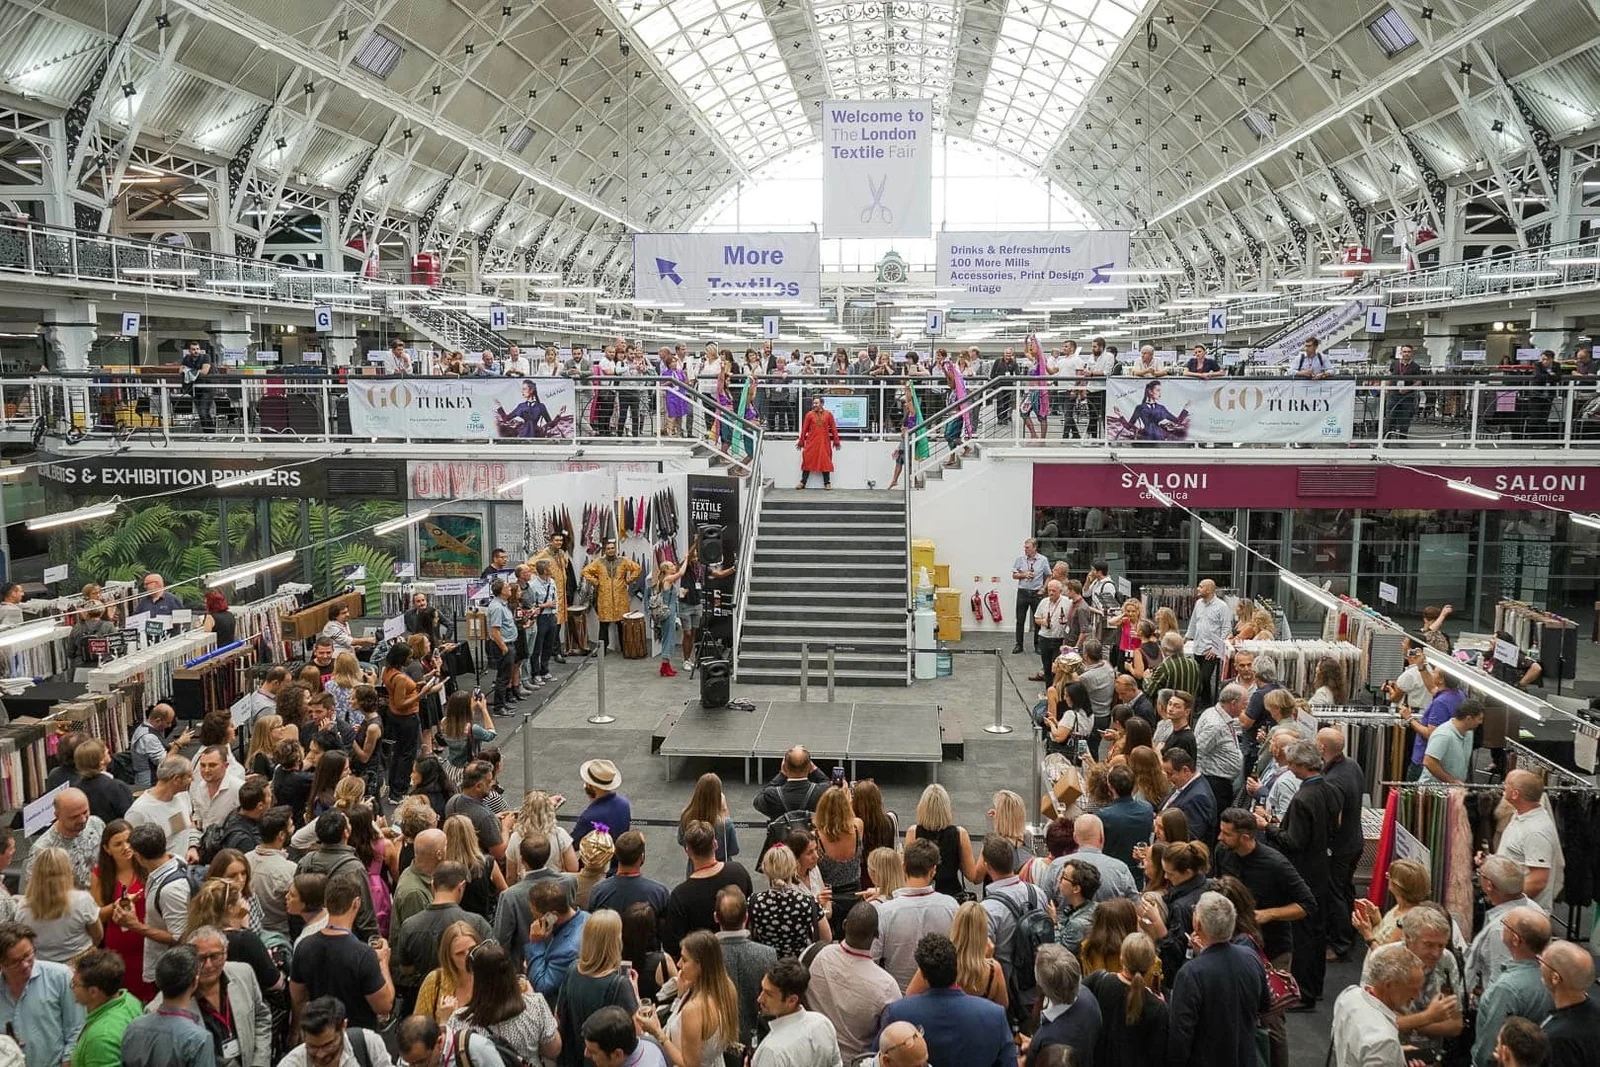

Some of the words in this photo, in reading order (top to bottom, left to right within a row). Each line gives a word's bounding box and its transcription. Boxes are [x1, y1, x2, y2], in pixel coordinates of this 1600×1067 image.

[831, 110, 903, 123] Welcome
[908, 109, 924, 122] to
[831, 128, 858, 141] The
[861, 127, 916, 141] London
[831, 145, 884, 159] Textile
[889, 145, 916, 158] Fair
[724, 245, 783, 265] More
[951, 245, 984, 255] Drinks
[987, 245, 996, 255] &
[1000, 245, 1071, 254] Refreshments
[951, 258, 971, 267] 100
[975, 258, 1001, 267] More
[1005, 258, 1030, 267] Mills
[950, 271, 1017, 281] Accessories,
[1020, 270, 1045, 280] Print
[1049, 270, 1084, 282] Design
[962, 283, 1002, 294] intage
[126, 318, 137, 331] F
[317, 312, 330, 326] G
[493, 311, 504, 325] H
[930, 315, 938, 329] J
[1211, 314, 1224, 329] K
[1371, 312, 1381, 327] L
[415, 384, 474, 396] WITH
[1268, 386, 1333, 398] WITH
[415, 396, 474, 409] TURKEY
[1267, 399, 1331, 412] TURKEY
[82, 467, 97, 484] &
[101, 468, 206, 486] EXHIBITION
[1121, 473, 1207, 489] SALONI
[1495, 474, 1585, 491] SALONI
[1139, 490, 1188, 500] cermica
[1514, 492, 1565, 502] cerámica
[691, 501, 722, 513] TEXTILE
[691, 511, 709, 521] FAIR
